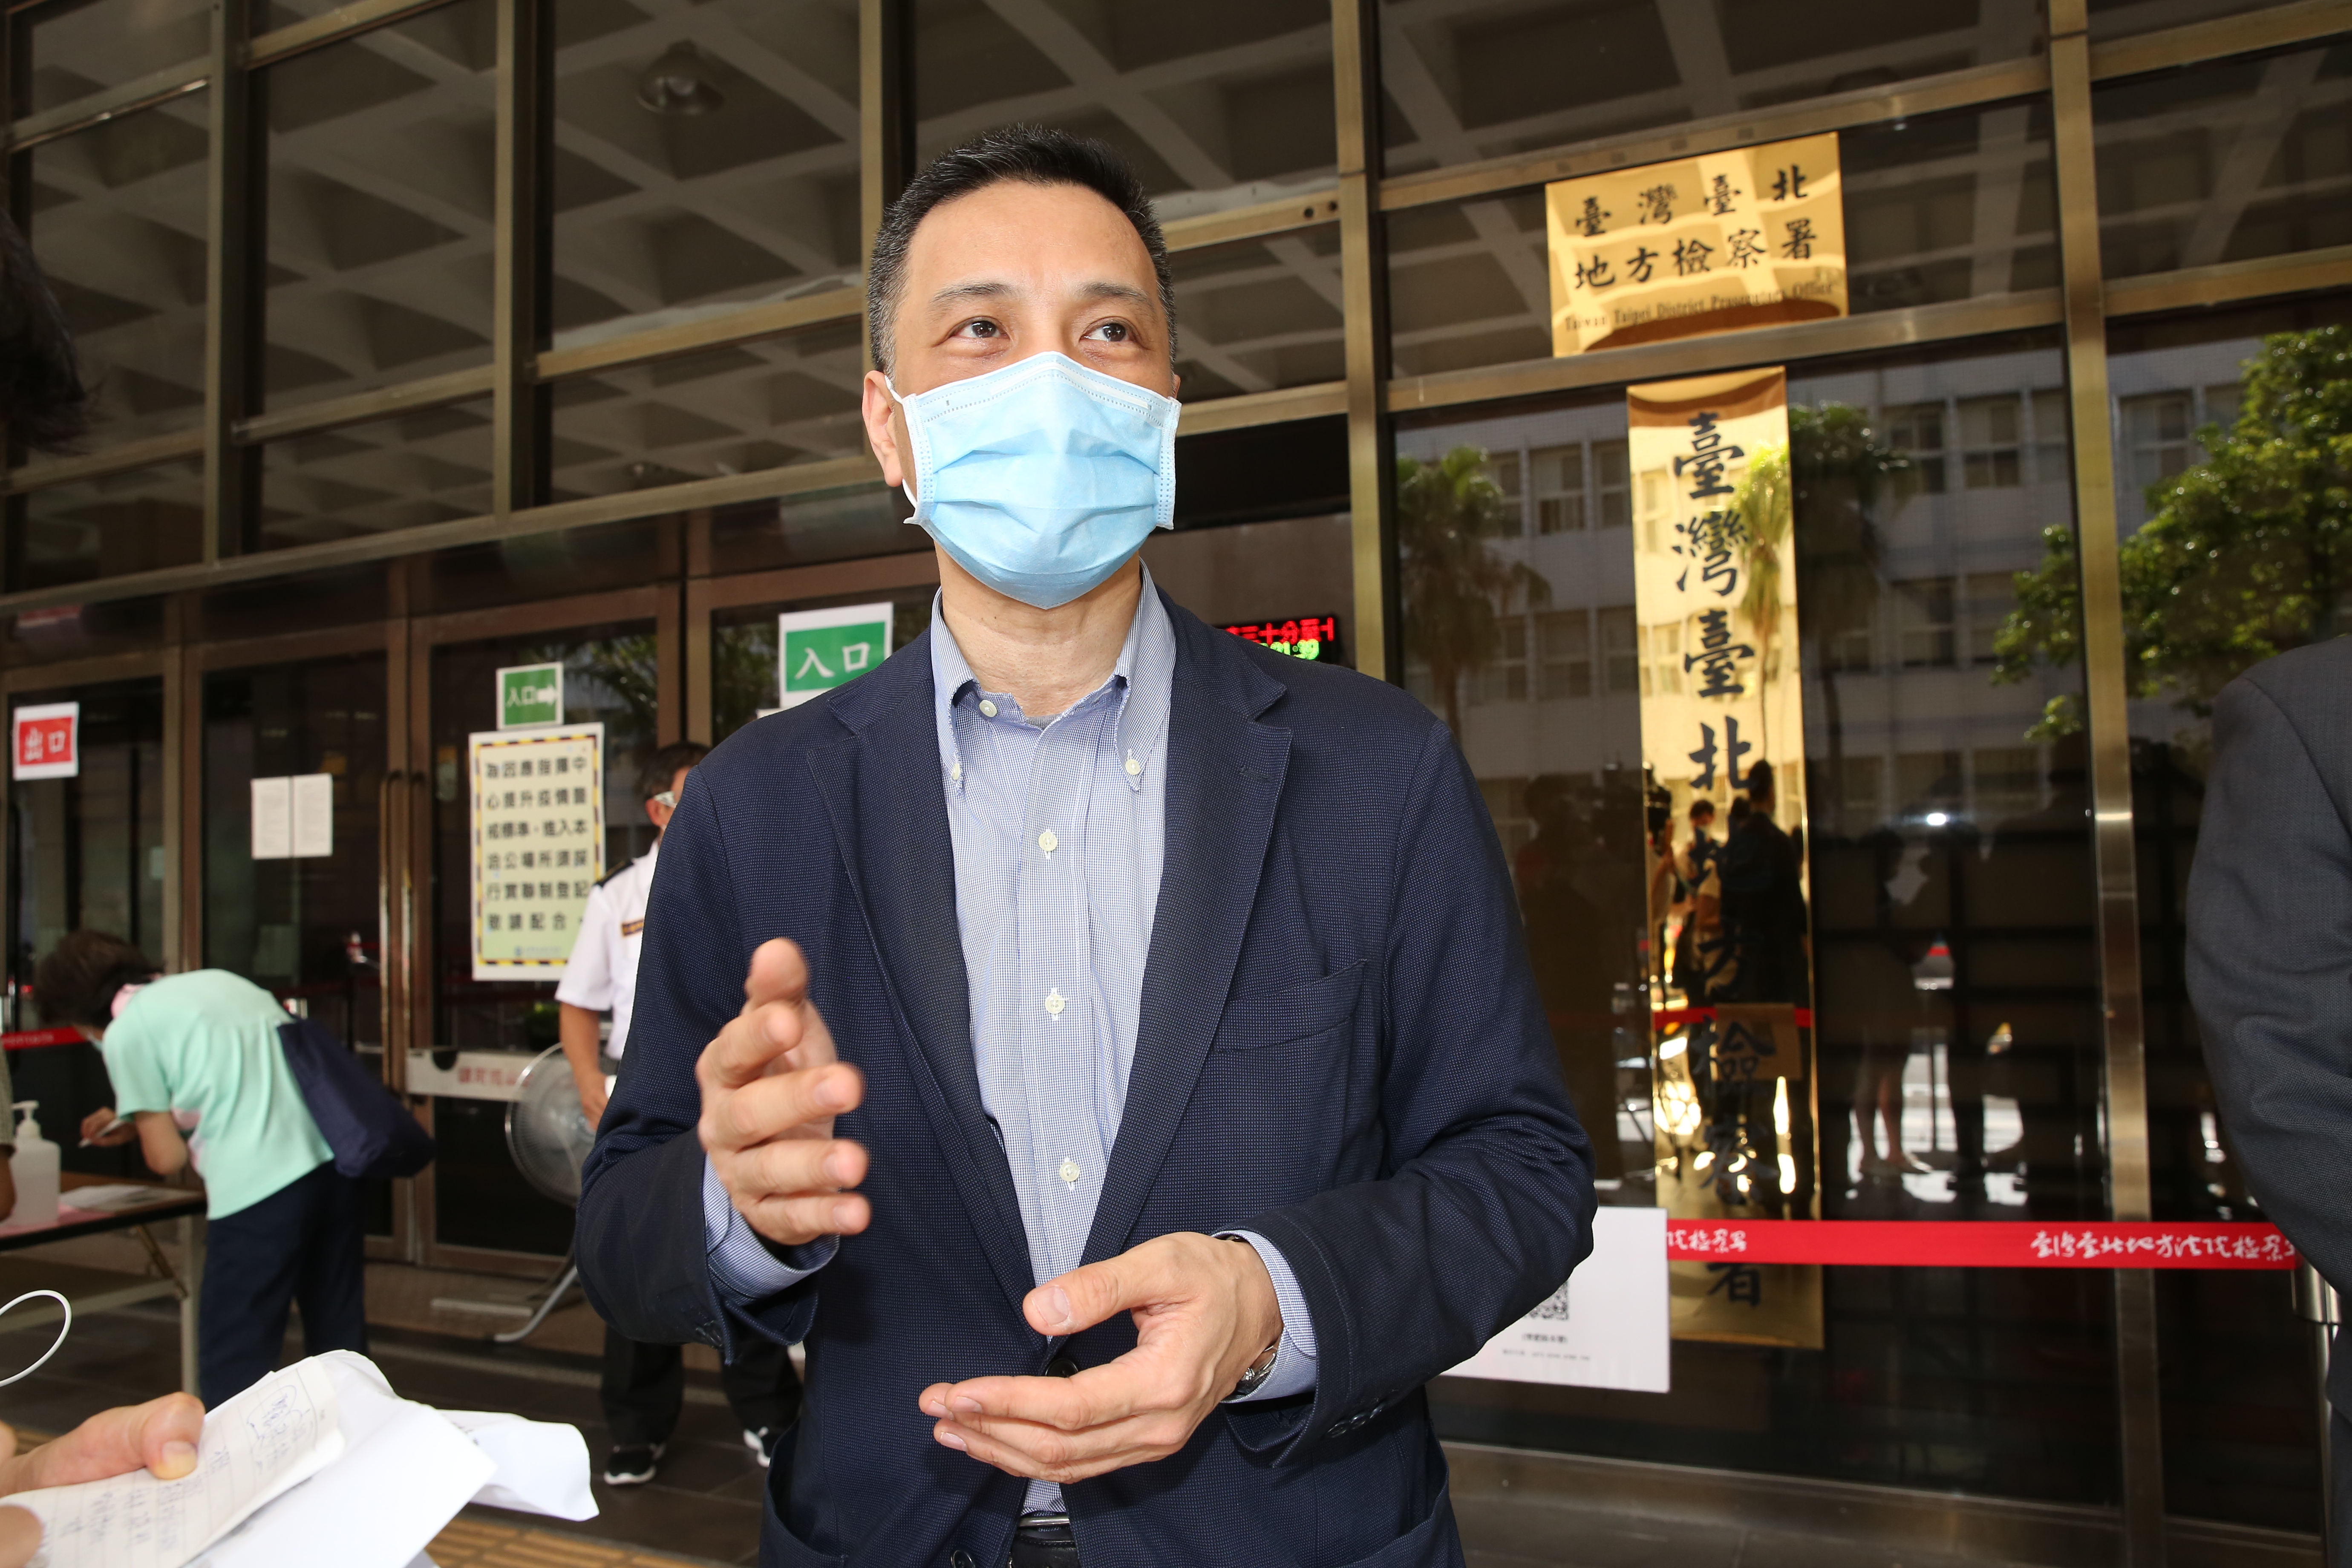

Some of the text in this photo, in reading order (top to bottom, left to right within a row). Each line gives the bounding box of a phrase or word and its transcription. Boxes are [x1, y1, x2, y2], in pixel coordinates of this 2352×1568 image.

[1575, 164, 1809, 238] 臺灣臺北
[1575, 217, 1817, 290] 地方檢察署
[1614, 308, 1651, 326] Taipei
[1657, 299, 1704, 322] District
[794, 642, 870, 680] 入口
[506, 686, 536, 706] 入口
[24, 727, 66, 761] 出口
